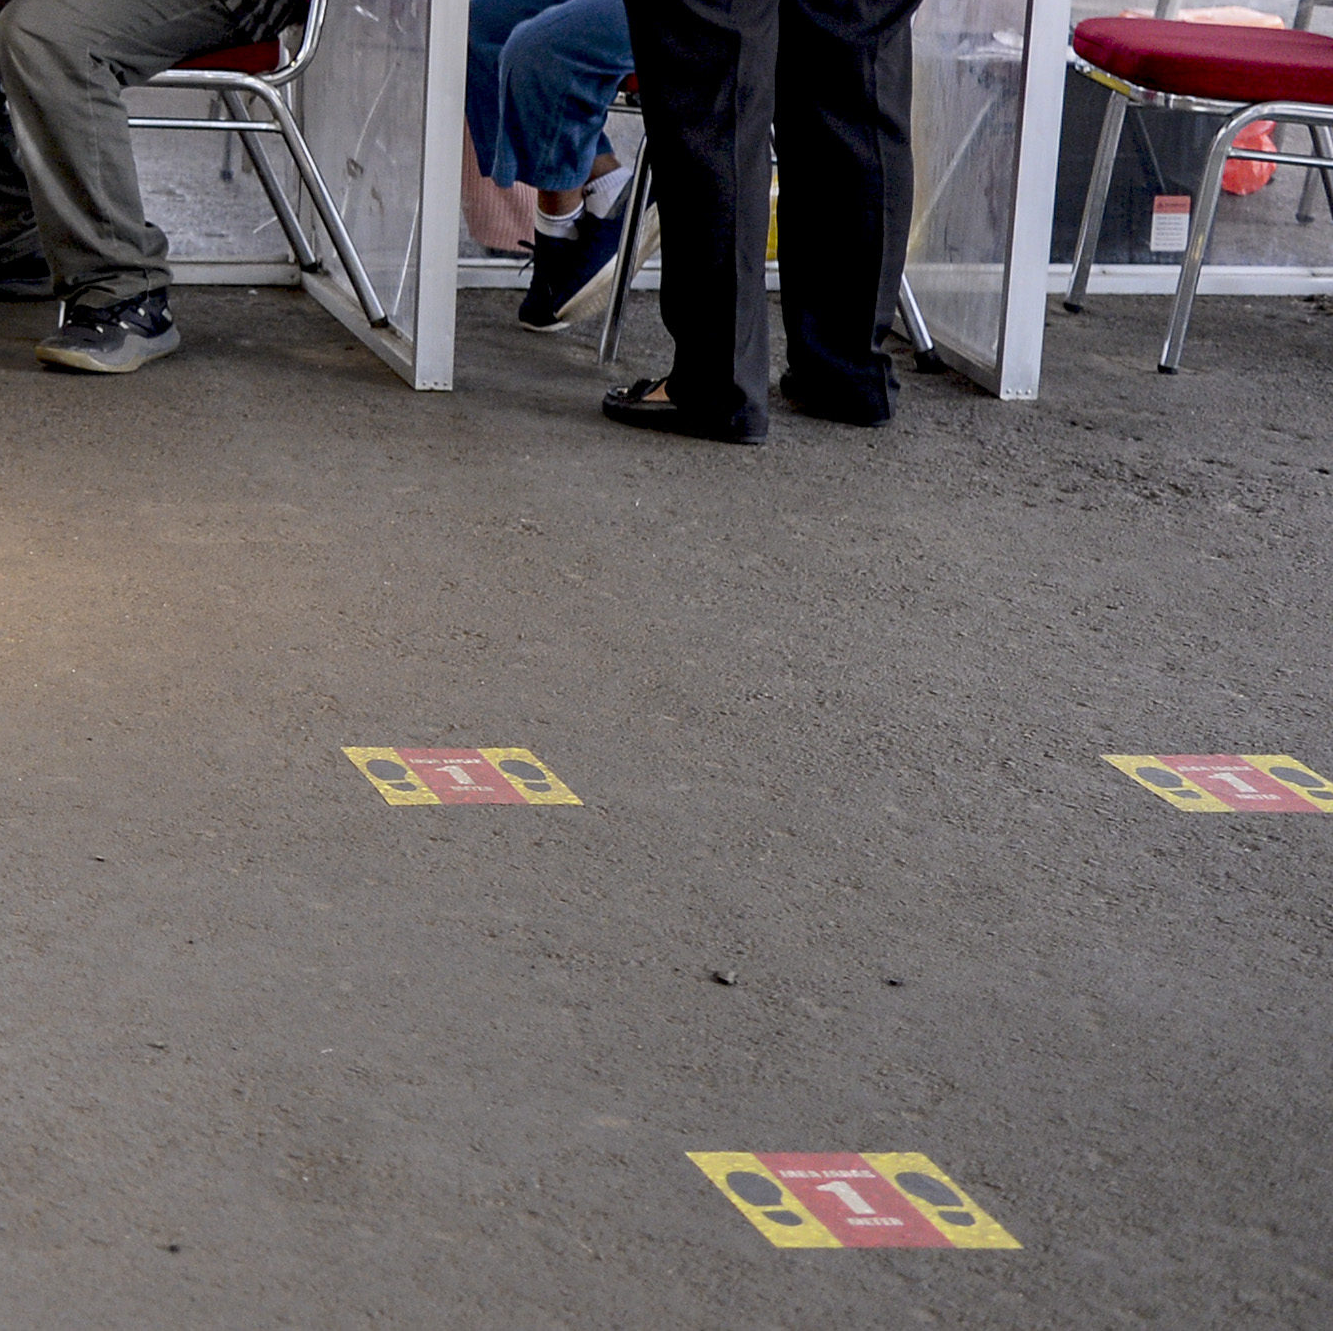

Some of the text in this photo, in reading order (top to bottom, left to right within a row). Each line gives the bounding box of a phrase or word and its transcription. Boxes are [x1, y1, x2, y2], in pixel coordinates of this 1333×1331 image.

[434, 765, 476, 785] 1
[1207, 771, 1259, 793] 1
[815, 1180, 877, 1215] 1
